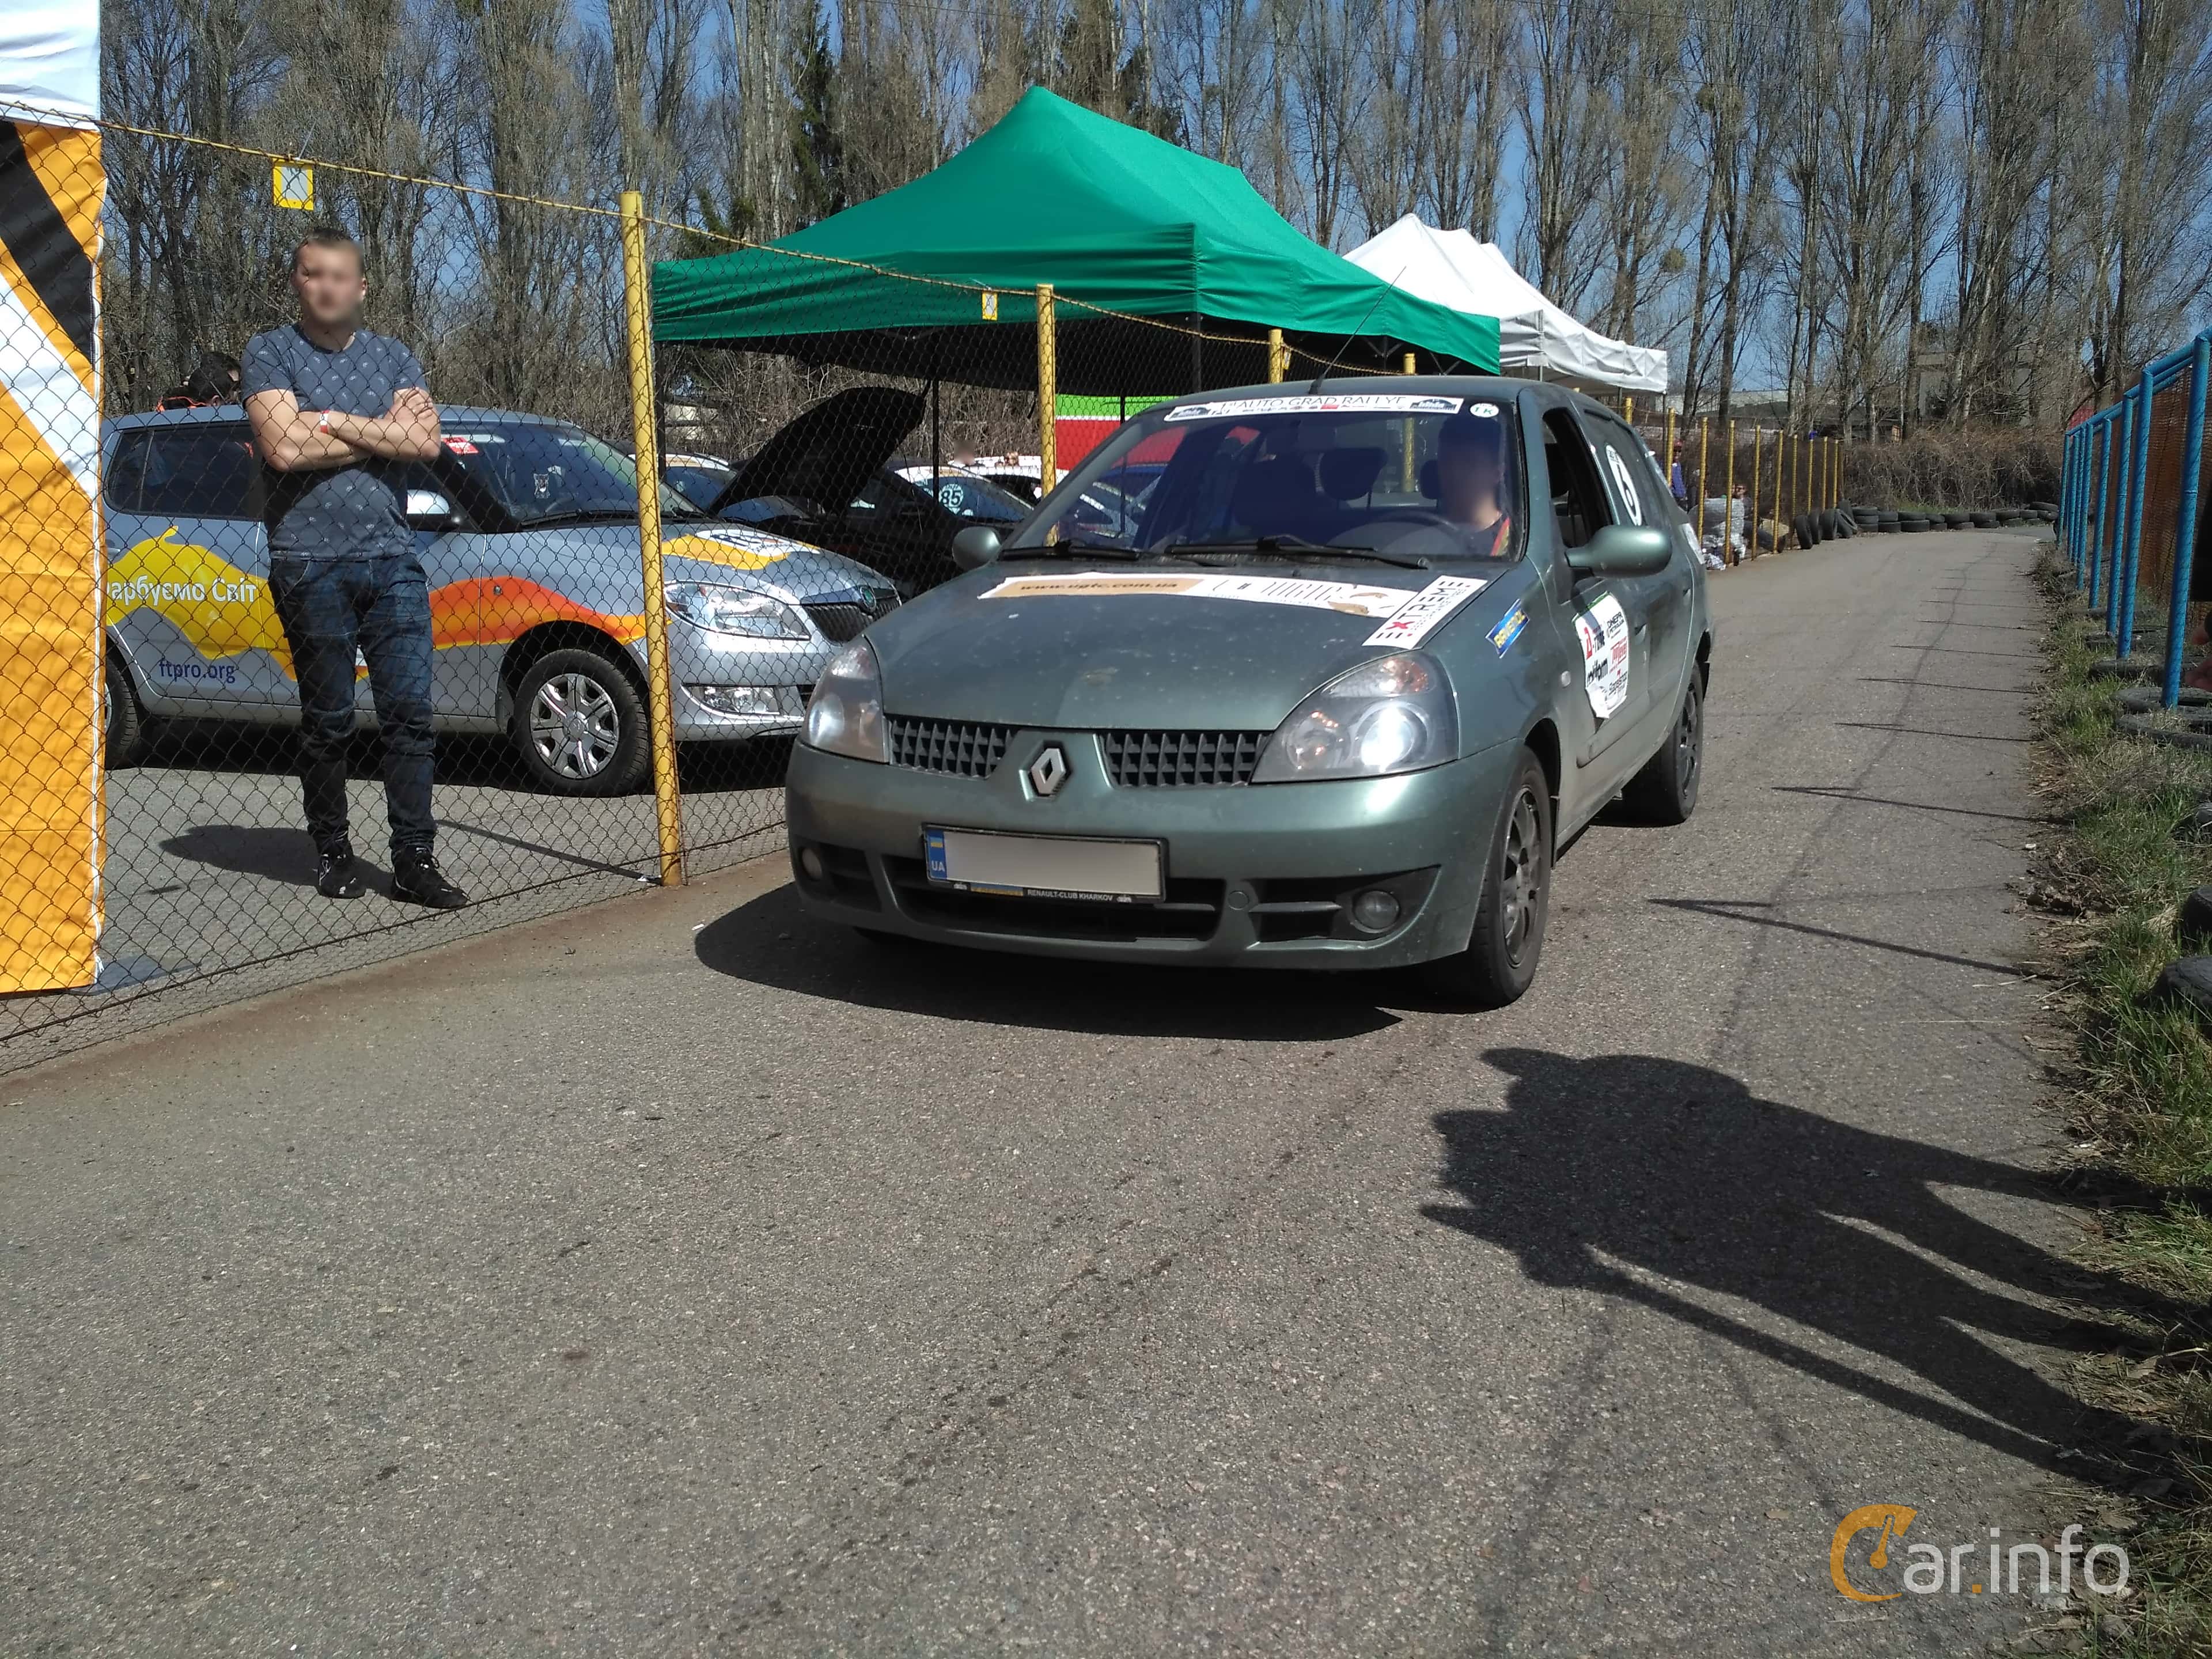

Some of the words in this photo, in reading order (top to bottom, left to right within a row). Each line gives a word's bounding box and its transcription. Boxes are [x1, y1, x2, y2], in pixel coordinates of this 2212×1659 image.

[1237, 398, 1283, 408] AUTO
[1289, 397, 1337, 406] GRAD
[940, 490, 961, 506] 85
[107, 575, 205, 605] арбуємо
[211, 577, 257, 603] Світ
[1375, 580, 1464, 639] EXTREME
[159, 661, 236, 684] ftpro.org
[931, 861, 945, 872] UA
[1027, 889, 1078, 900] RENAULT-CLUB
[1079, 892, 1113, 901] KHARKOV
